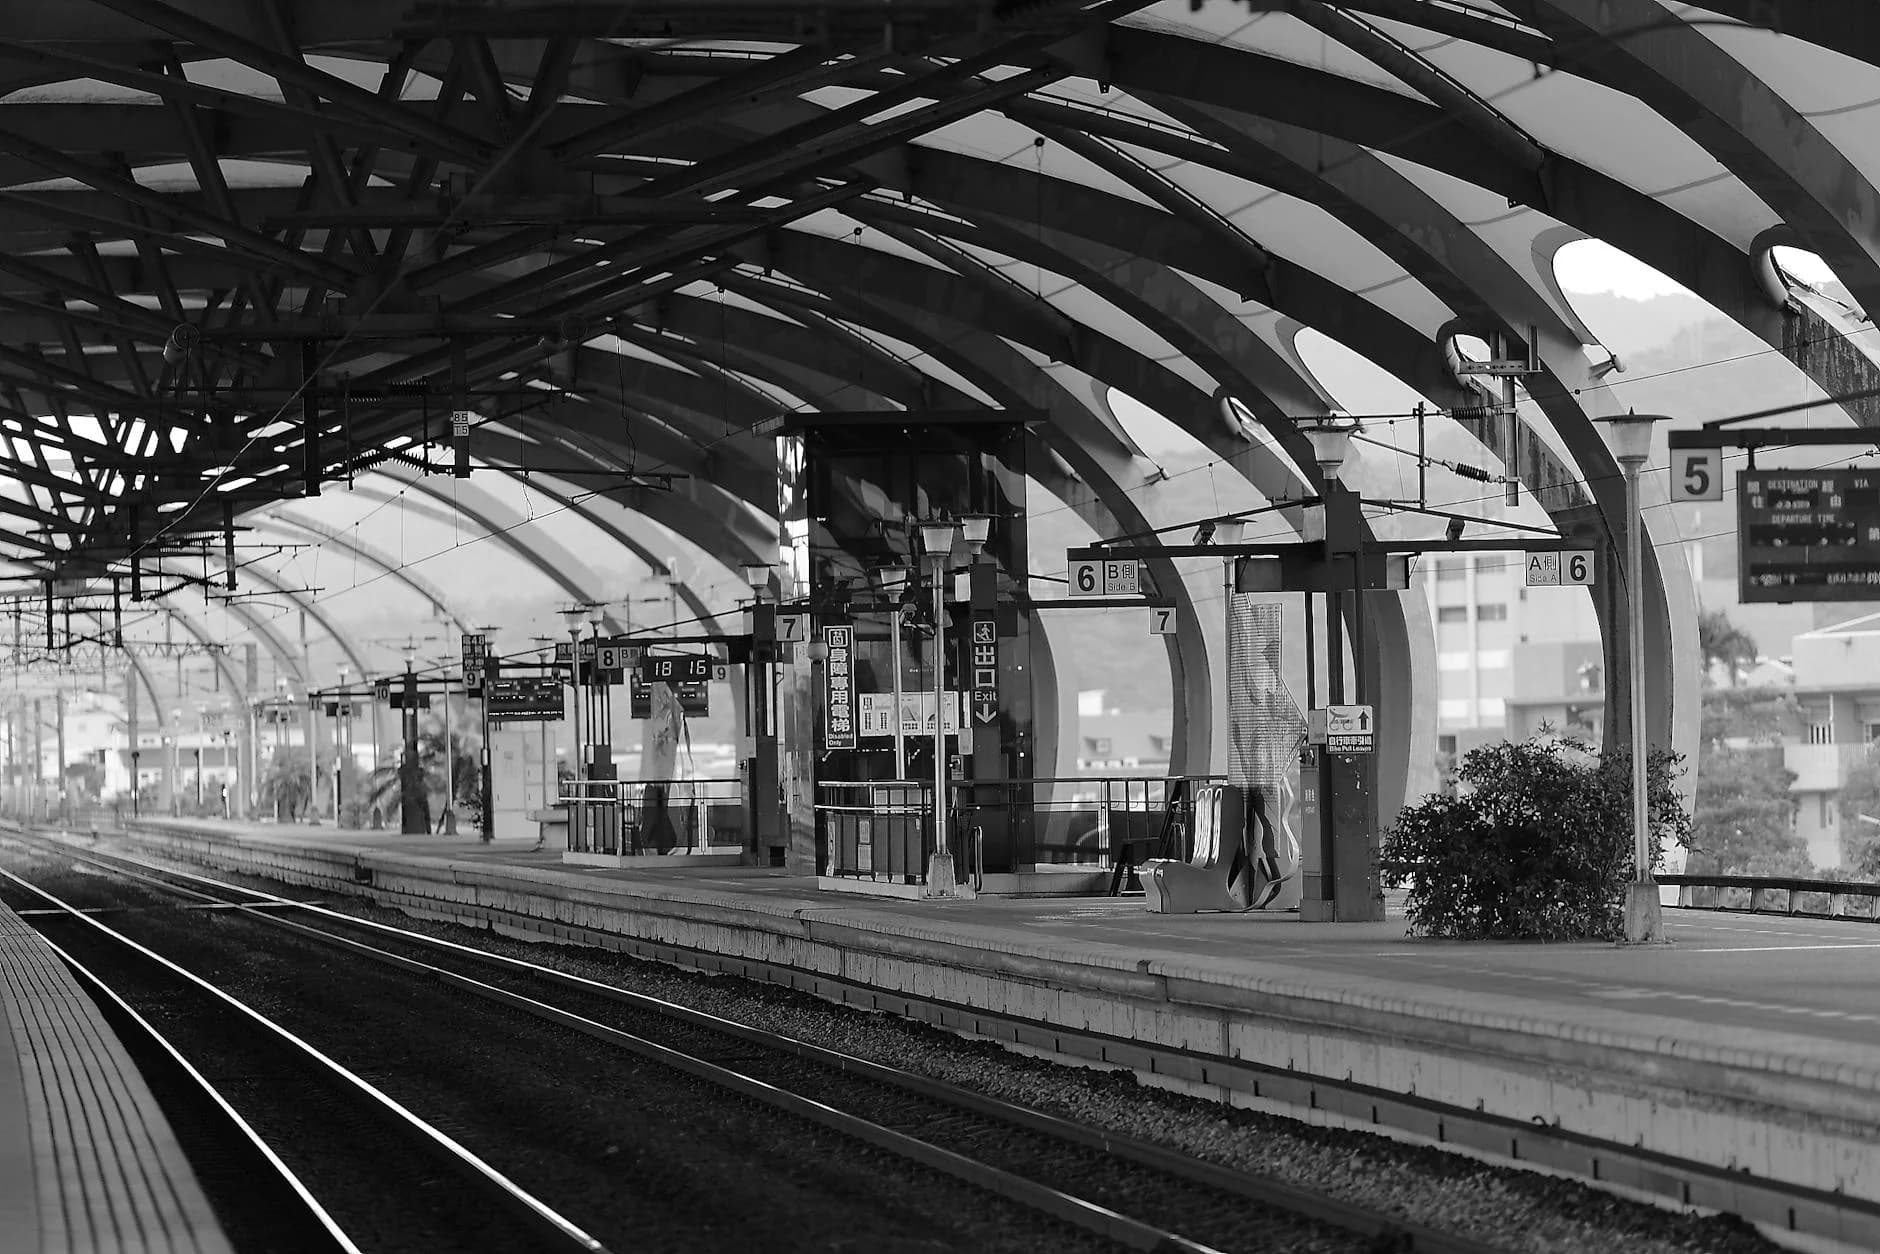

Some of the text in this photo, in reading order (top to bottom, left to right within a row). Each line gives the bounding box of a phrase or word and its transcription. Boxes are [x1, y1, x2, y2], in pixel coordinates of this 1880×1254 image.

[1684, 456, 1710, 495] 5
[1854, 479, 1869, 488] VIA
[1530, 555, 1557, 570] A側
[1570, 555, 1587, 581] 6
[1077, 565, 1095, 591] 6
[1109, 564, 1135, 579] B側
[783, 618, 795, 639] 7
[1157, 611, 1170, 631] 7
[603, 650, 614, 666] 8
[656, 660, 706, 677] 18 16
[717, 666, 726, 680] 9
[974, 645, 995, 688] 出口
[467, 672, 476, 686] 9
[377, 687, 388, 700] 10
[974, 691, 997, 701] Exit
